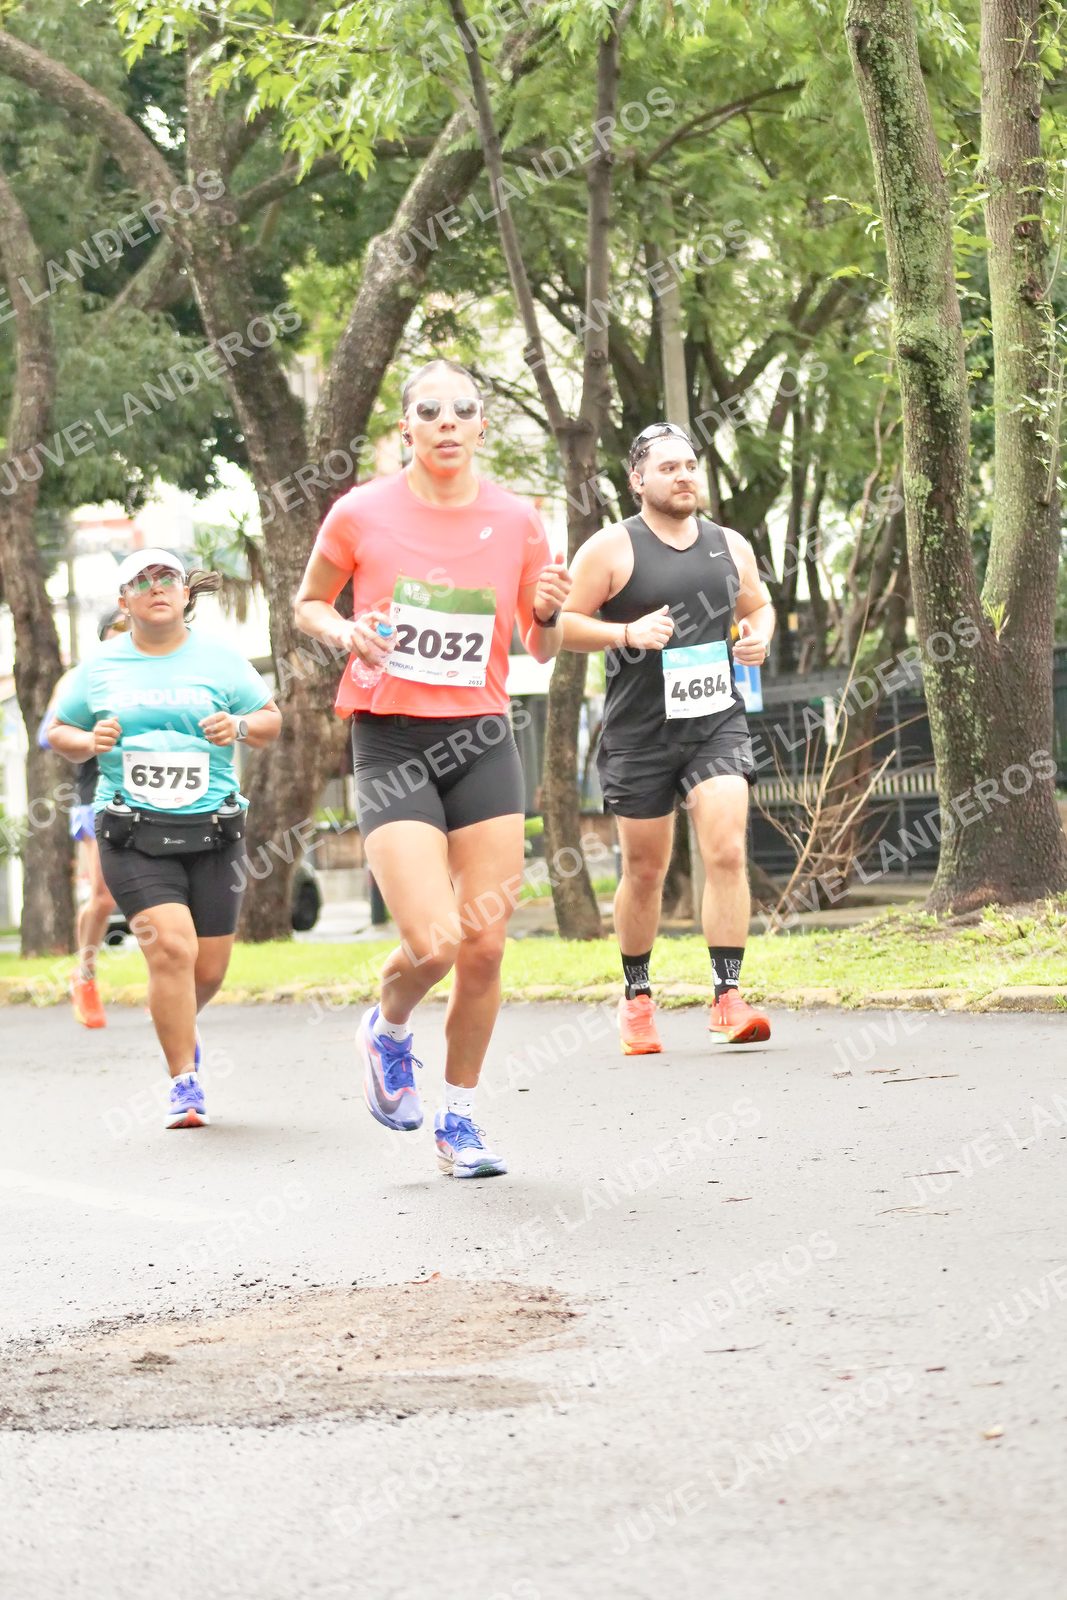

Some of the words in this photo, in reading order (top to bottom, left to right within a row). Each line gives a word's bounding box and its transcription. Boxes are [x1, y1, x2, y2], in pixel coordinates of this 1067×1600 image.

[394, 624, 484, 662] 2032
[671, 674, 727, 702] 4684
[131, 764, 202, 790] 6375
